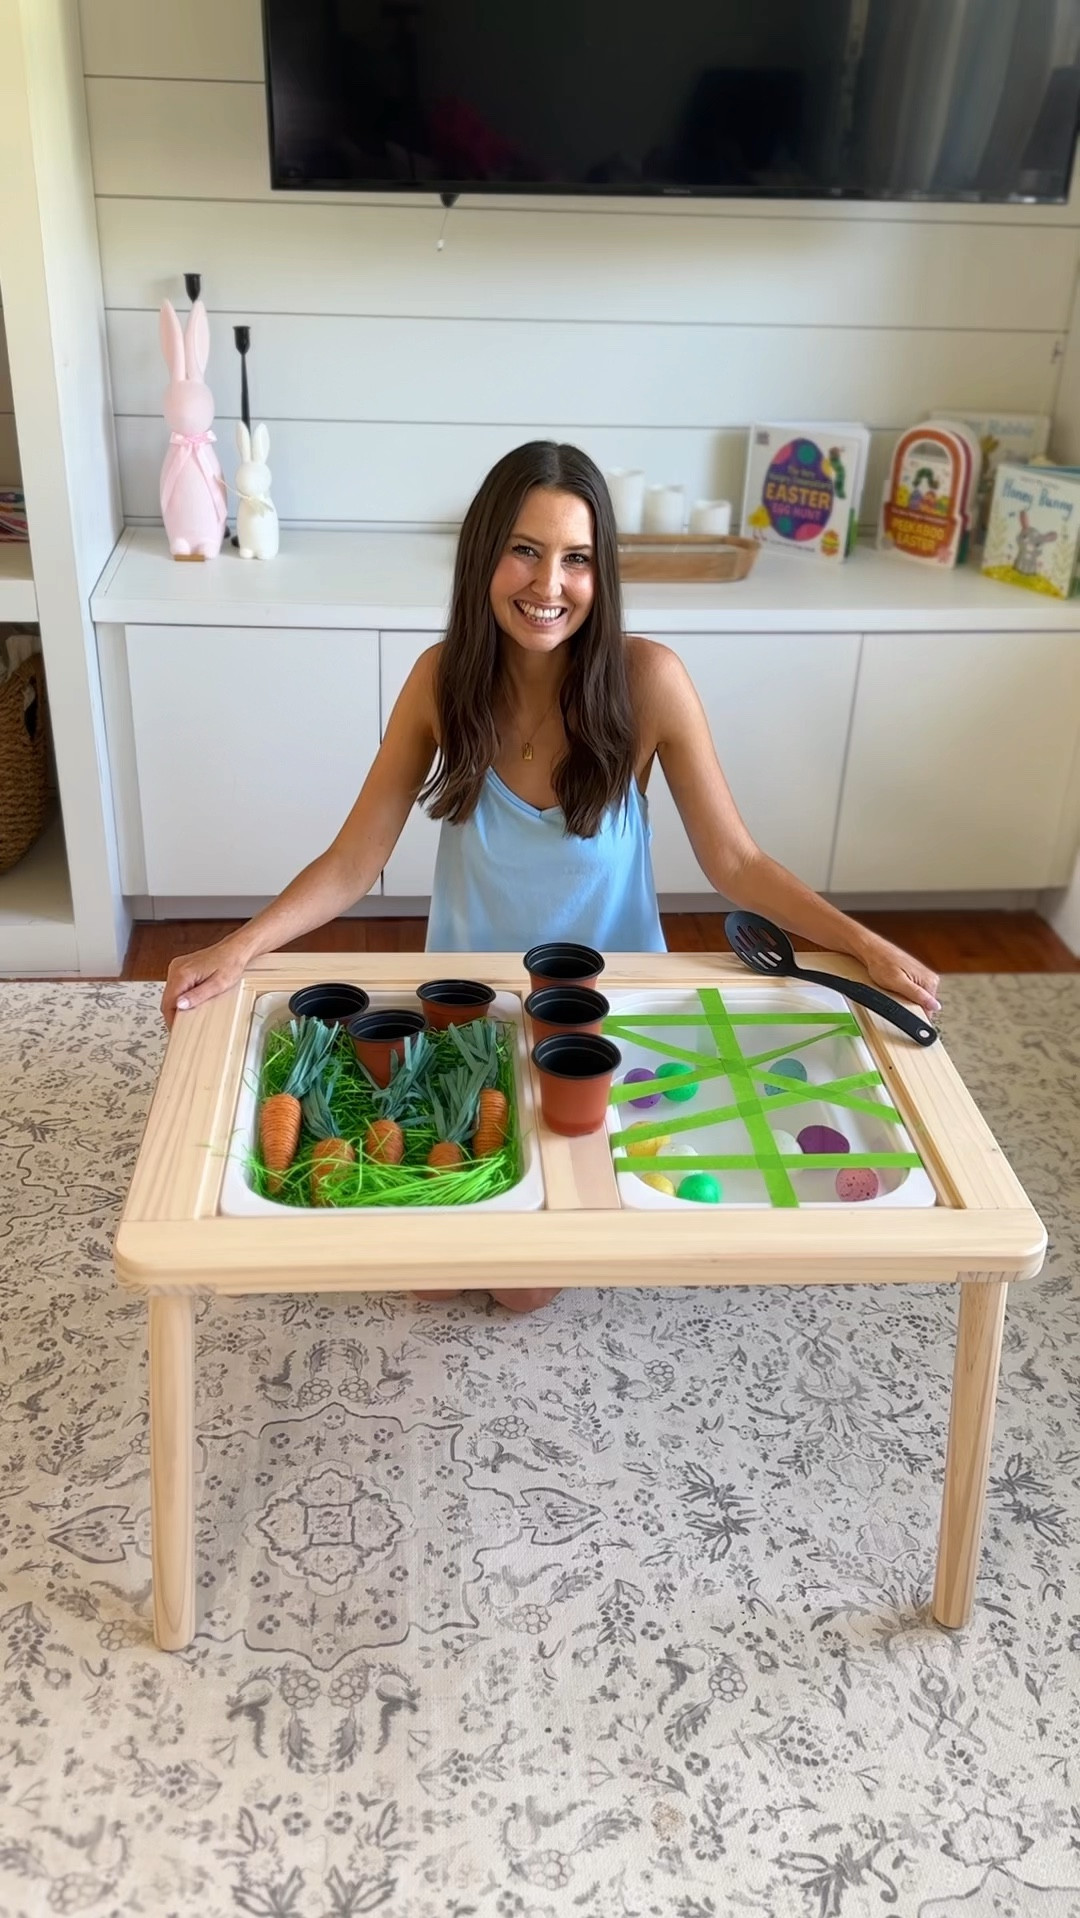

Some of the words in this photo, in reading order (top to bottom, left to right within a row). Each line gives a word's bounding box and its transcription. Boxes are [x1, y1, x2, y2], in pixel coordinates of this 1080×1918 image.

[766, 482, 831, 510] EASTER
[1002, 478, 1033, 511] Honey
[1039, 488, 1073, 521] Bunny
[772, 502, 791, 515] EGG
[794, 507, 821, 520] HUNT
[896, 532, 937, 551] EASTER
